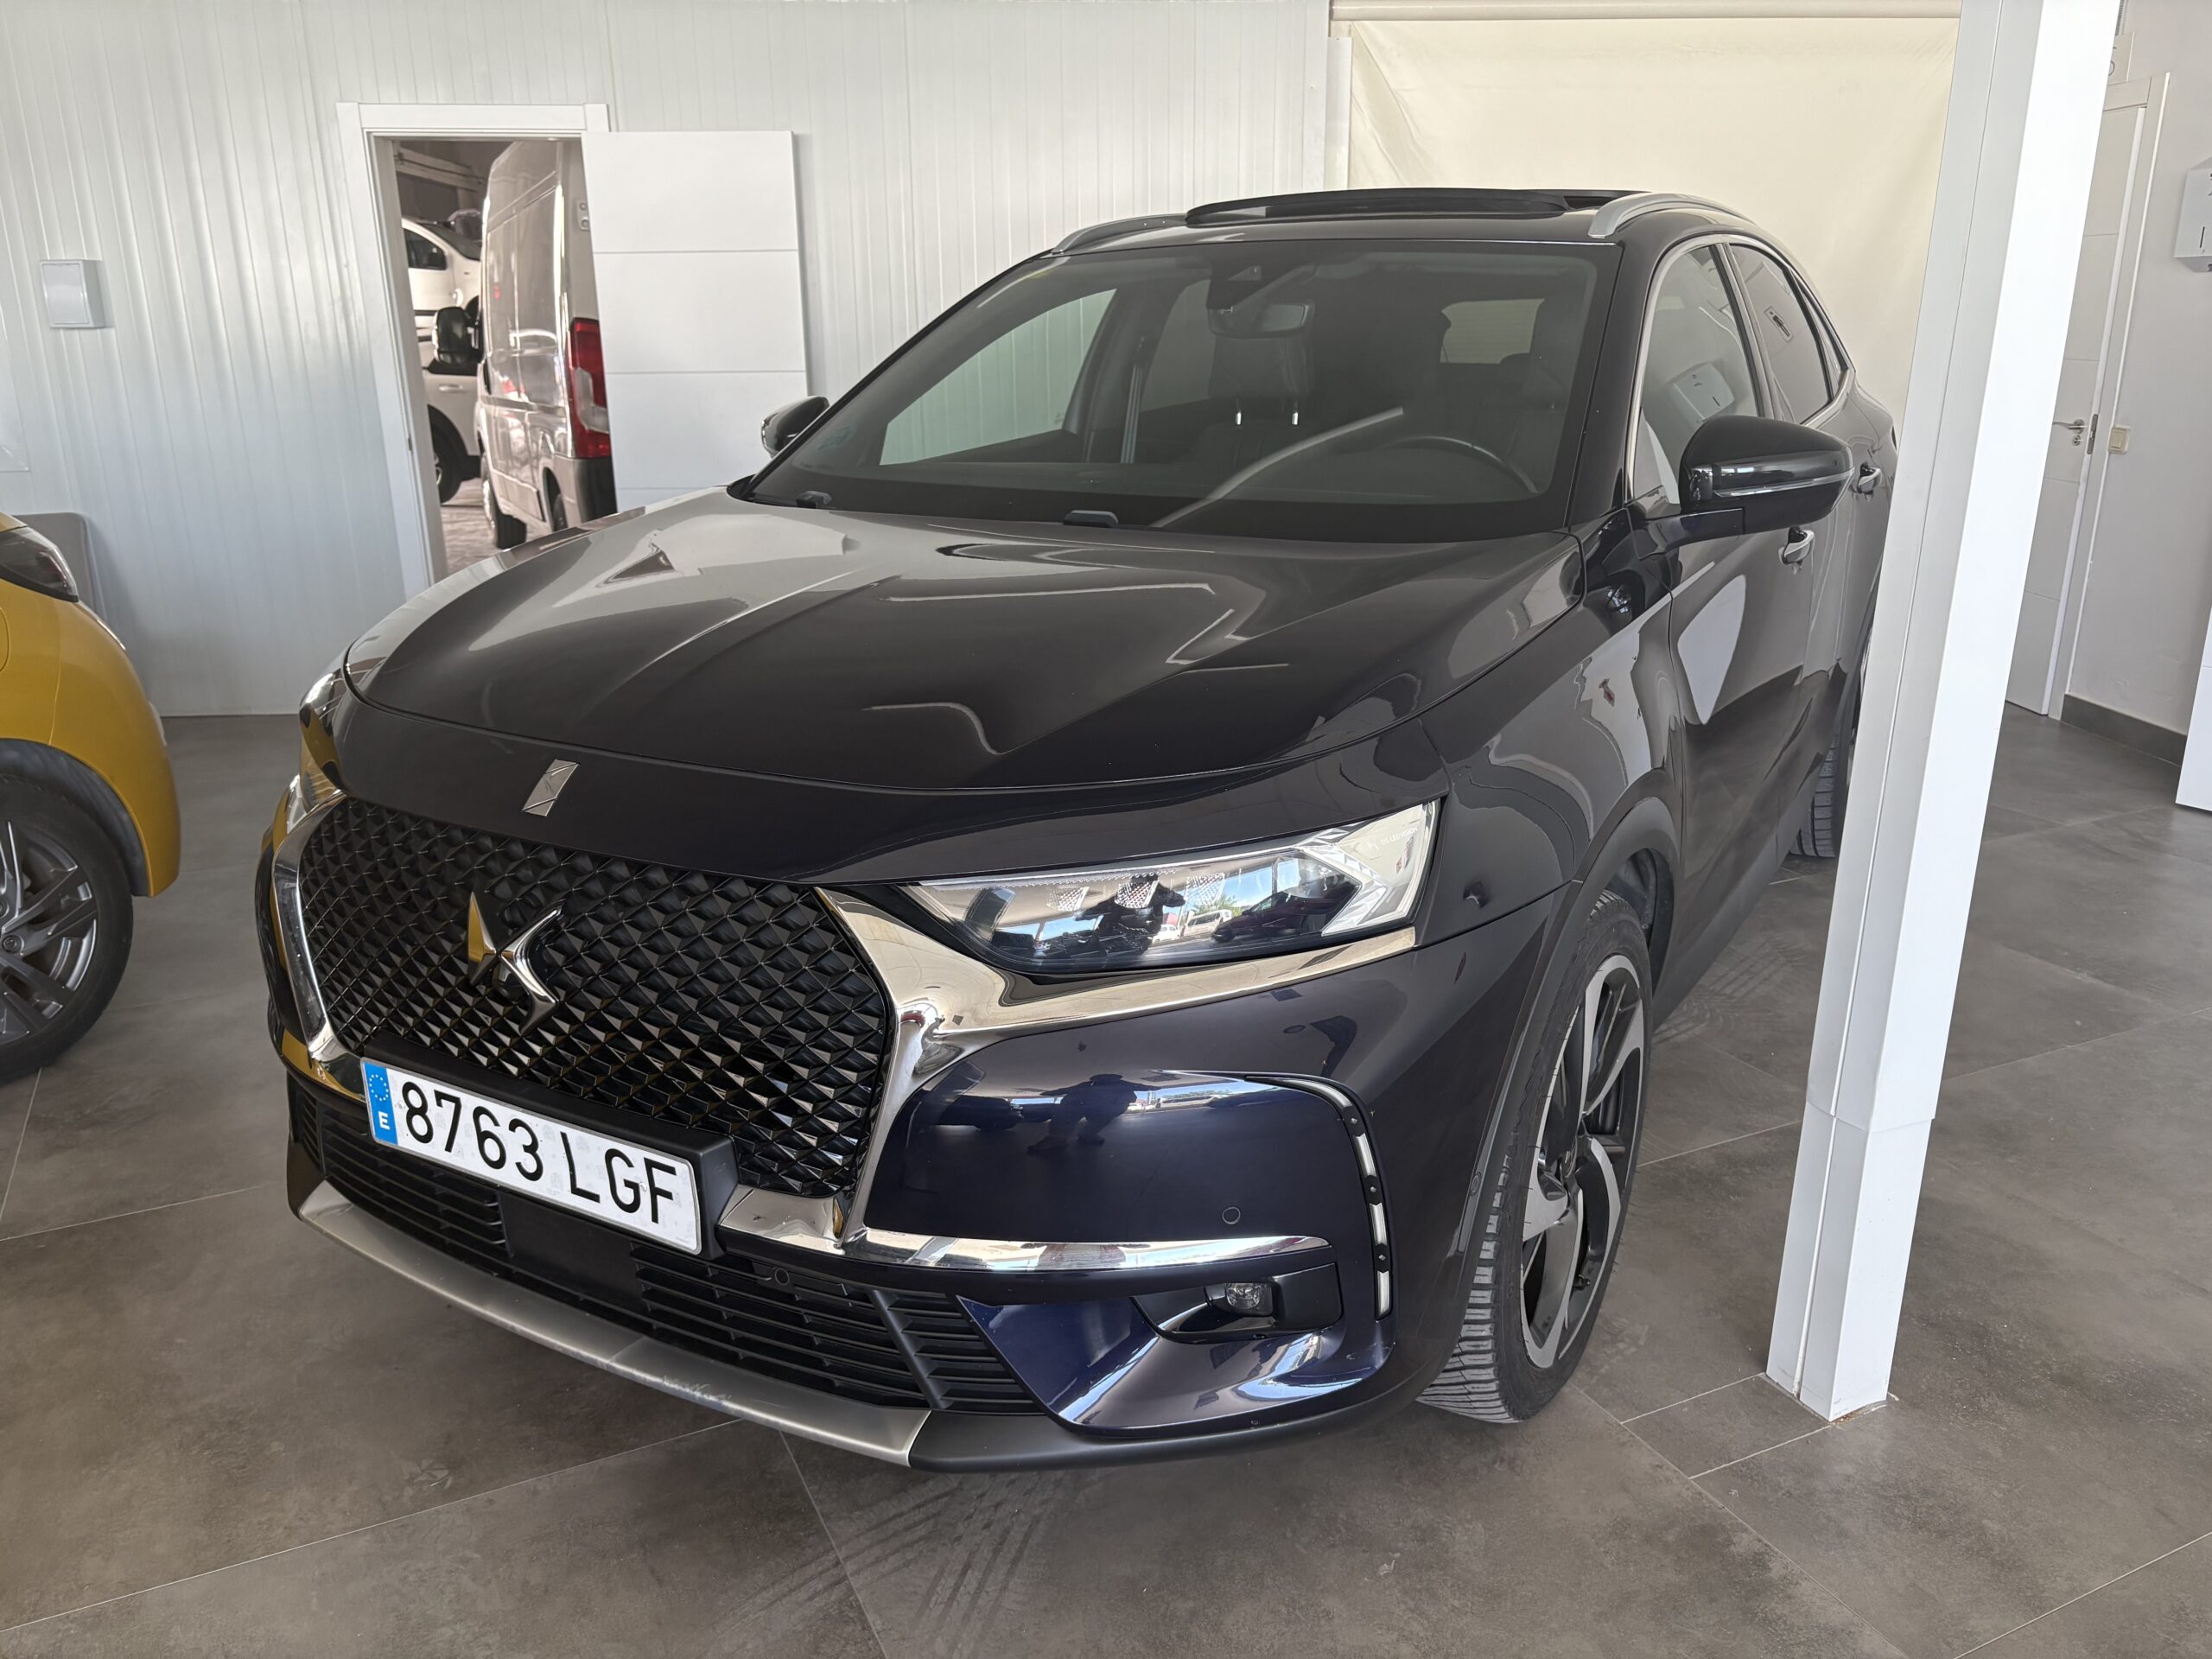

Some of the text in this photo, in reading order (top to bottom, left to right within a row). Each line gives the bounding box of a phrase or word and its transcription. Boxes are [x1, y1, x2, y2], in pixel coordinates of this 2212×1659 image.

[378, 1110, 391, 1130] E
[402, 1081, 677, 1224] 8763 LGF
